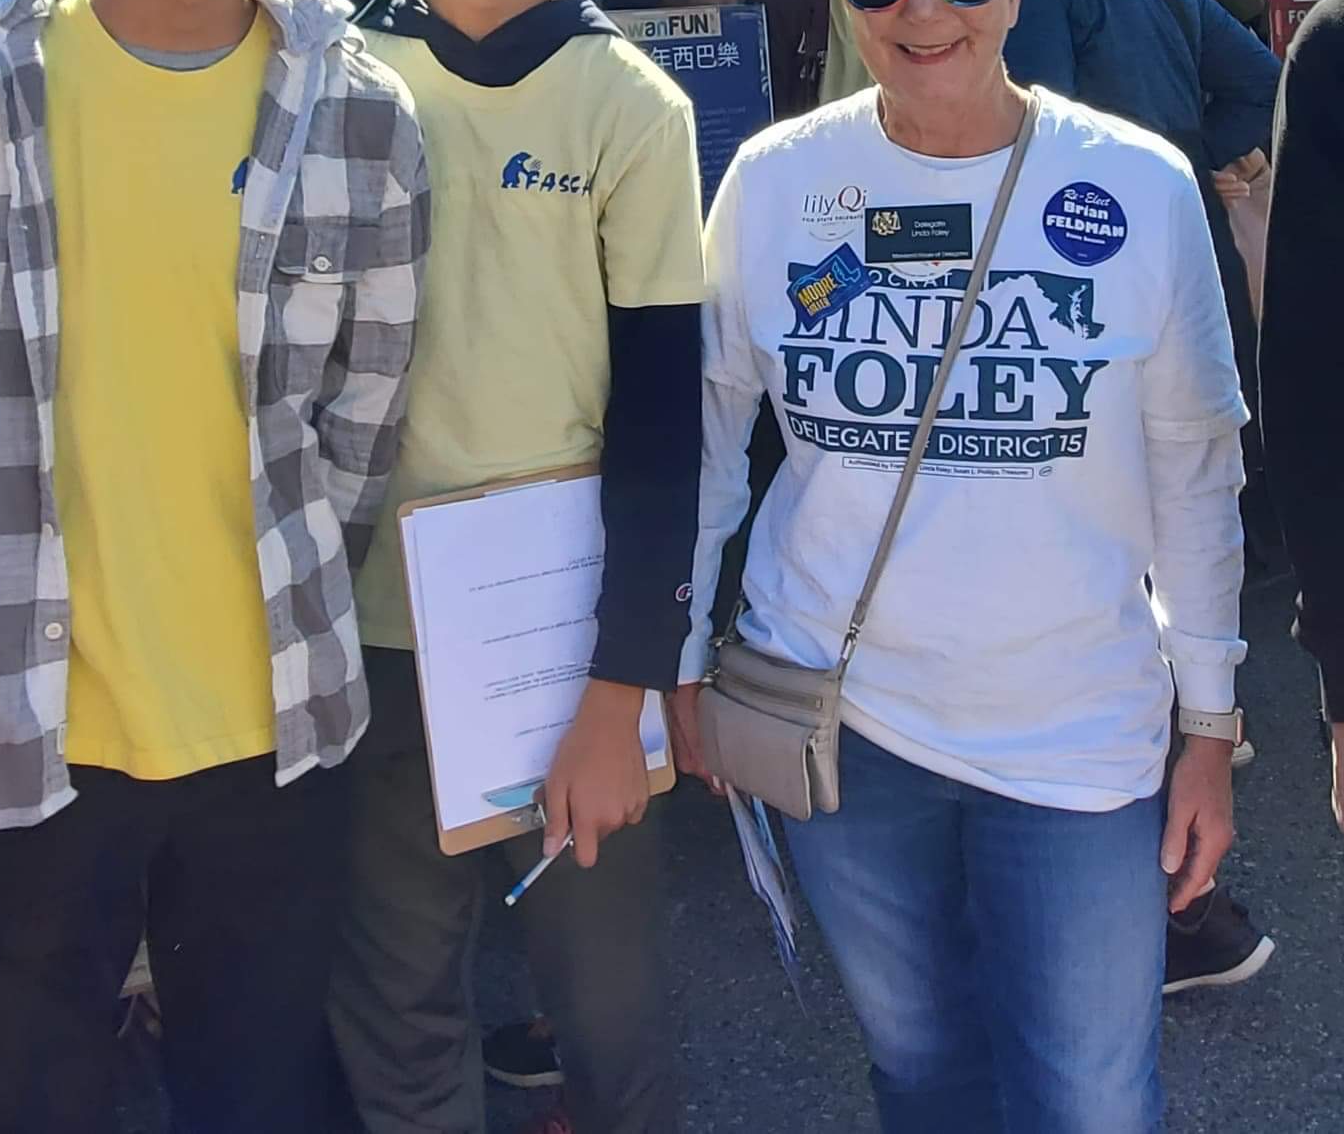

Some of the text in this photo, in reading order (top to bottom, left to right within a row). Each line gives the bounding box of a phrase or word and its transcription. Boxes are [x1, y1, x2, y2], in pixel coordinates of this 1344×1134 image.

[640, 42, 740, 71] 年西巴樂
[1046, 214, 1125, 238] FELDMAN
[1063, 200, 1109, 220] Brian
[783, 291, 1048, 350] LINDA
[778, 345, 1110, 421] FOLEY
[789, 417, 1083, 457] DELEGATE DISTRICT 15
